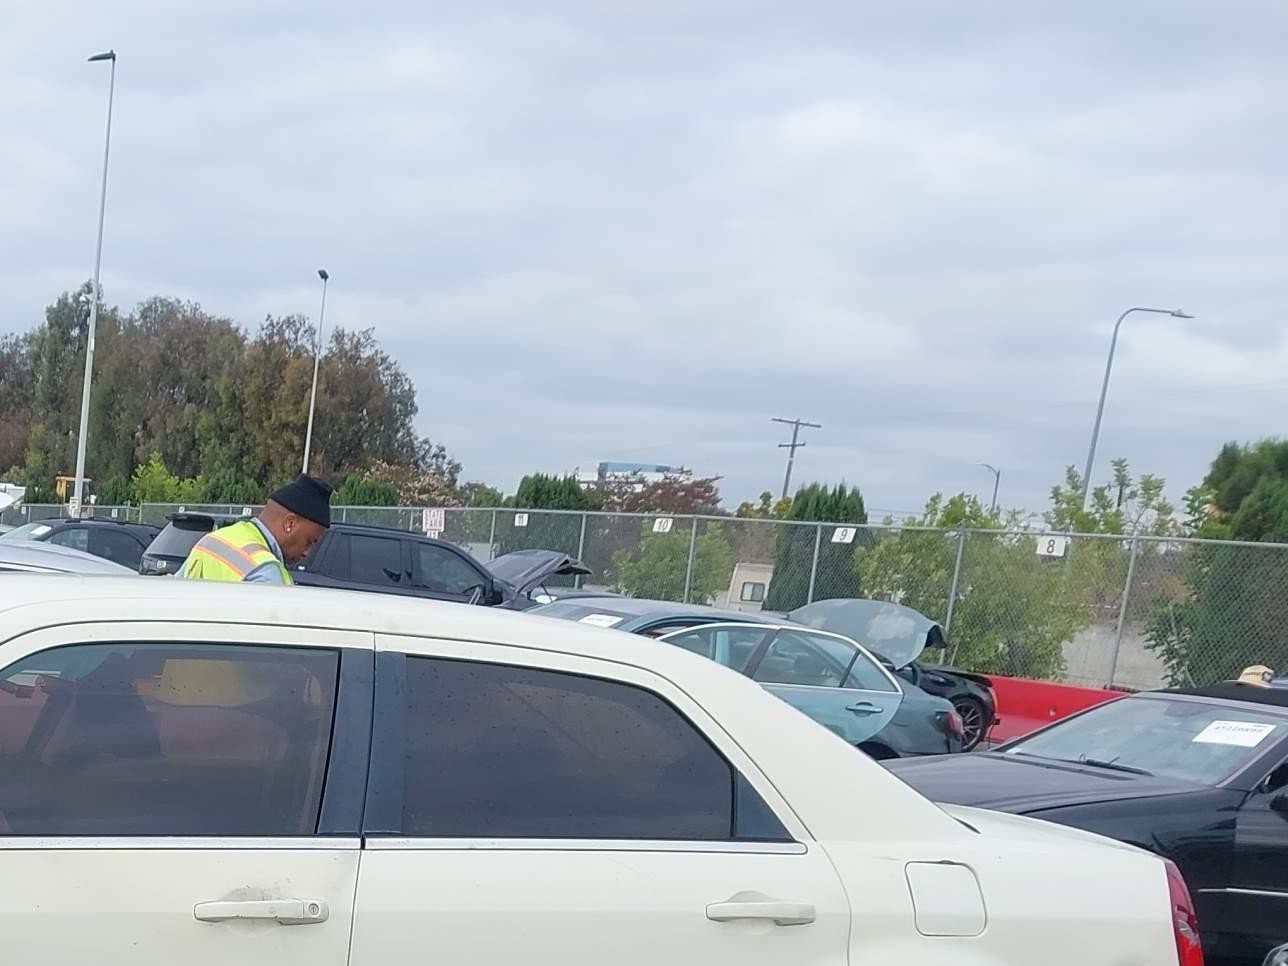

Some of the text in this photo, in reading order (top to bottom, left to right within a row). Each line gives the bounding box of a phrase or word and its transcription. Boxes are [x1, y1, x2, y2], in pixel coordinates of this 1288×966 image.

[657, 519, 669, 531] 10
[839, 529, 849, 541] 9
[1046, 539, 1056, 554] 8
